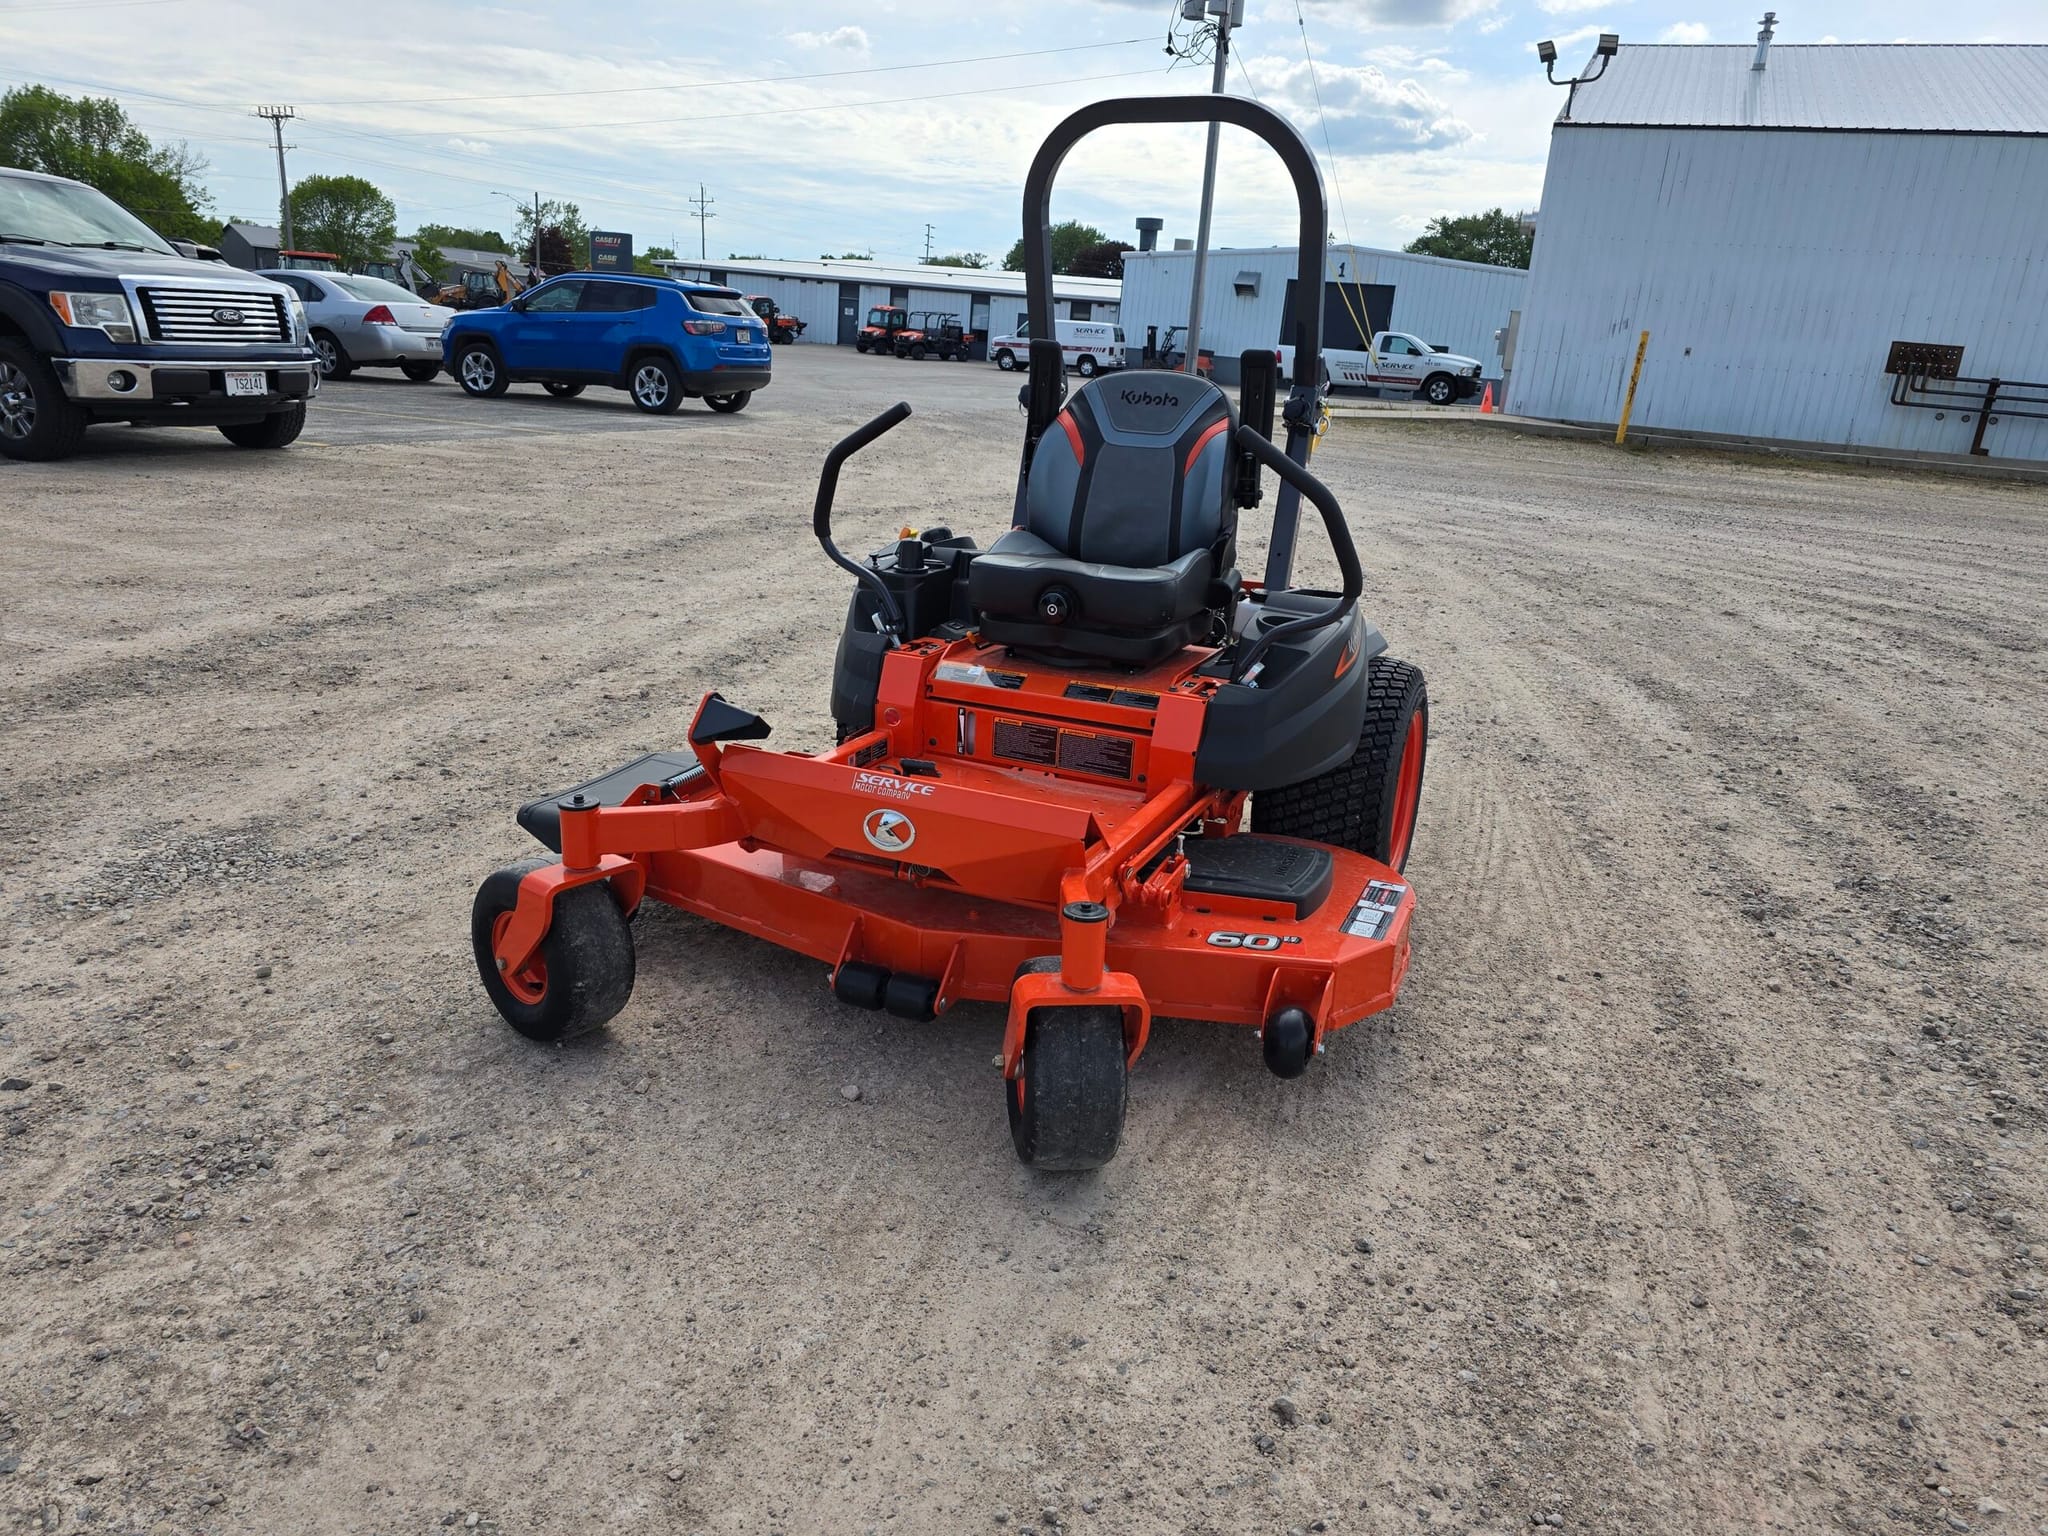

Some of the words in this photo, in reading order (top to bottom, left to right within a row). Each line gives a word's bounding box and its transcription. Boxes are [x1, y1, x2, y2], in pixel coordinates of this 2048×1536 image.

[1338, 262, 1345, 277] 1
[222, 311, 239, 320] Ford
[1075, 327, 1105, 335] SERVICE
[1381, 362, 1415, 370] SERVICE
[234, 378, 263, 389] TS2141
[1121, 390, 1179, 407] Kubota
[857, 772, 936, 796] SERVICE
